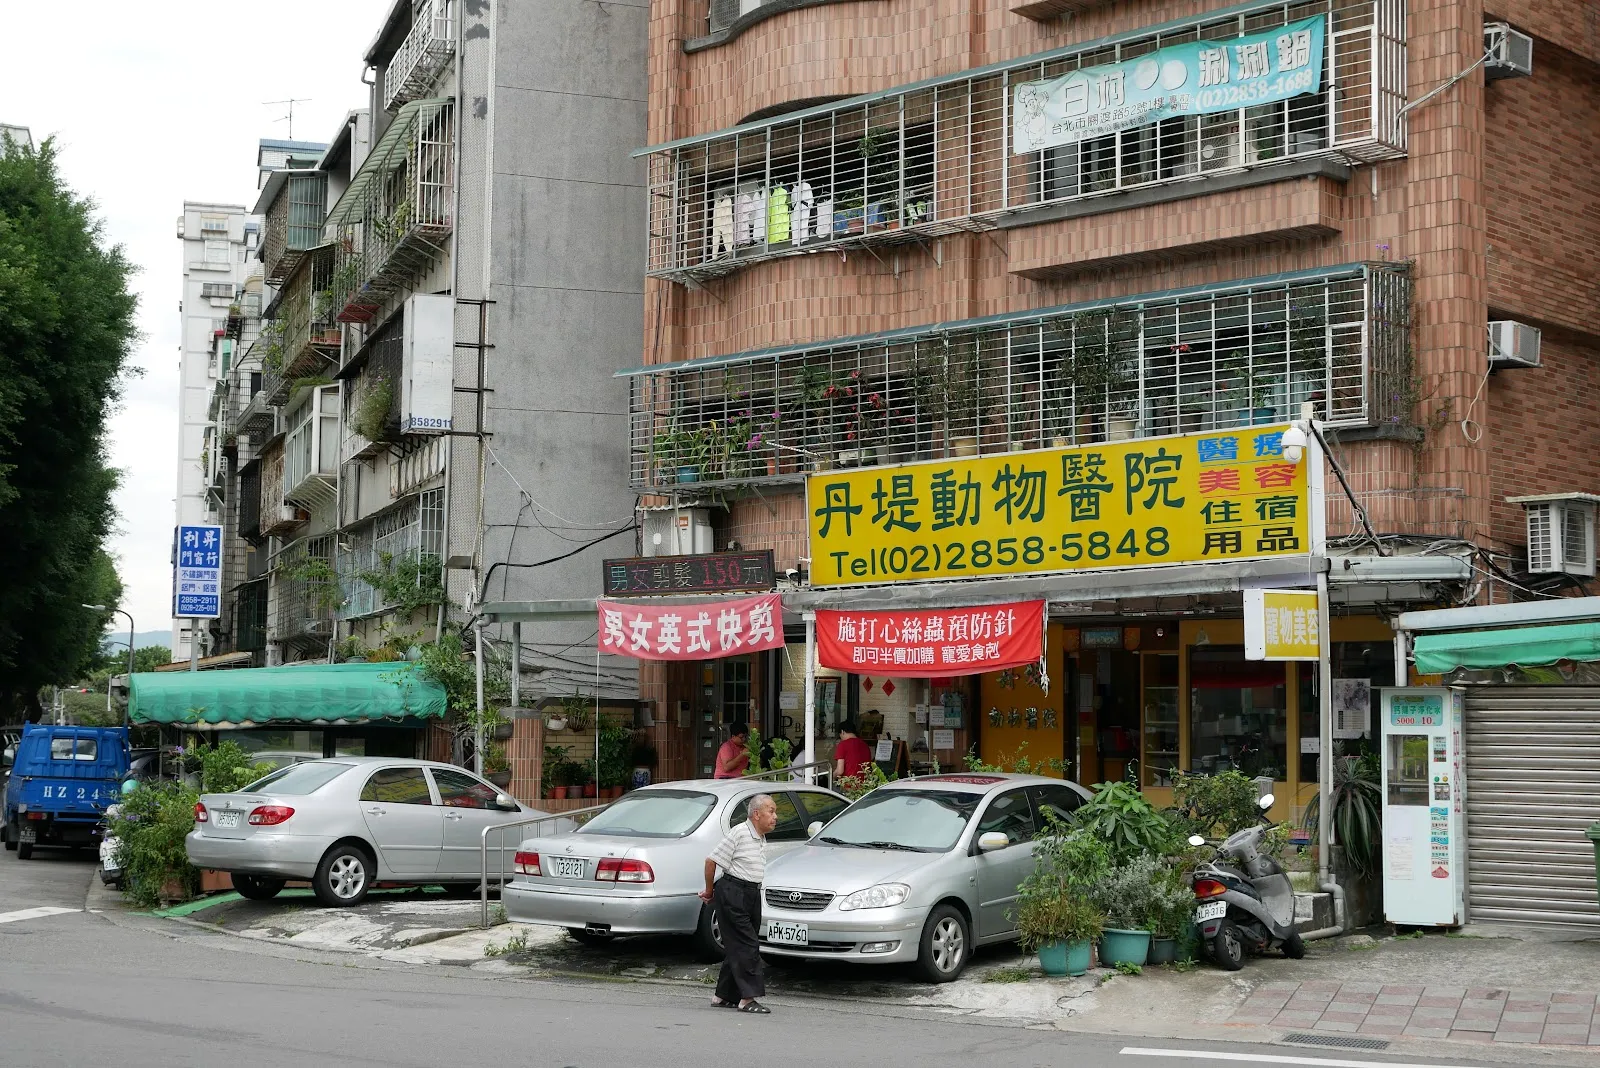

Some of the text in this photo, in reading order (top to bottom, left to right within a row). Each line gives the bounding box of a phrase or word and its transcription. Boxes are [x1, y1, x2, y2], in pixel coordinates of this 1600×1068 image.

[1197, 29, 1312, 88] 涮涮鍋
[1195, 69, 1313, 111] (02)2858-1688
[814, 446, 1187, 540] 丹堤動物醫院
[1198, 463, 1299, 495] 美容
[1199, 494, 1300, 526] 住宿
[1201, 526, 1301, 556] 用品
[611, 562, 693, 591] 男女剪髮
[181, 595, 217, 605] 2858-2911
[603, 602, 776, 654] 男女英式快剪
[837, 608, 1018, 644] 施打心絲蟲預防針
[1265, 607, 1319, 645] 寵物美容
[853, 646, 935, 665] 即可半價加購
[1422, 716, 1433, 725] 10
[768, 925, 807, 942] APK-5760
